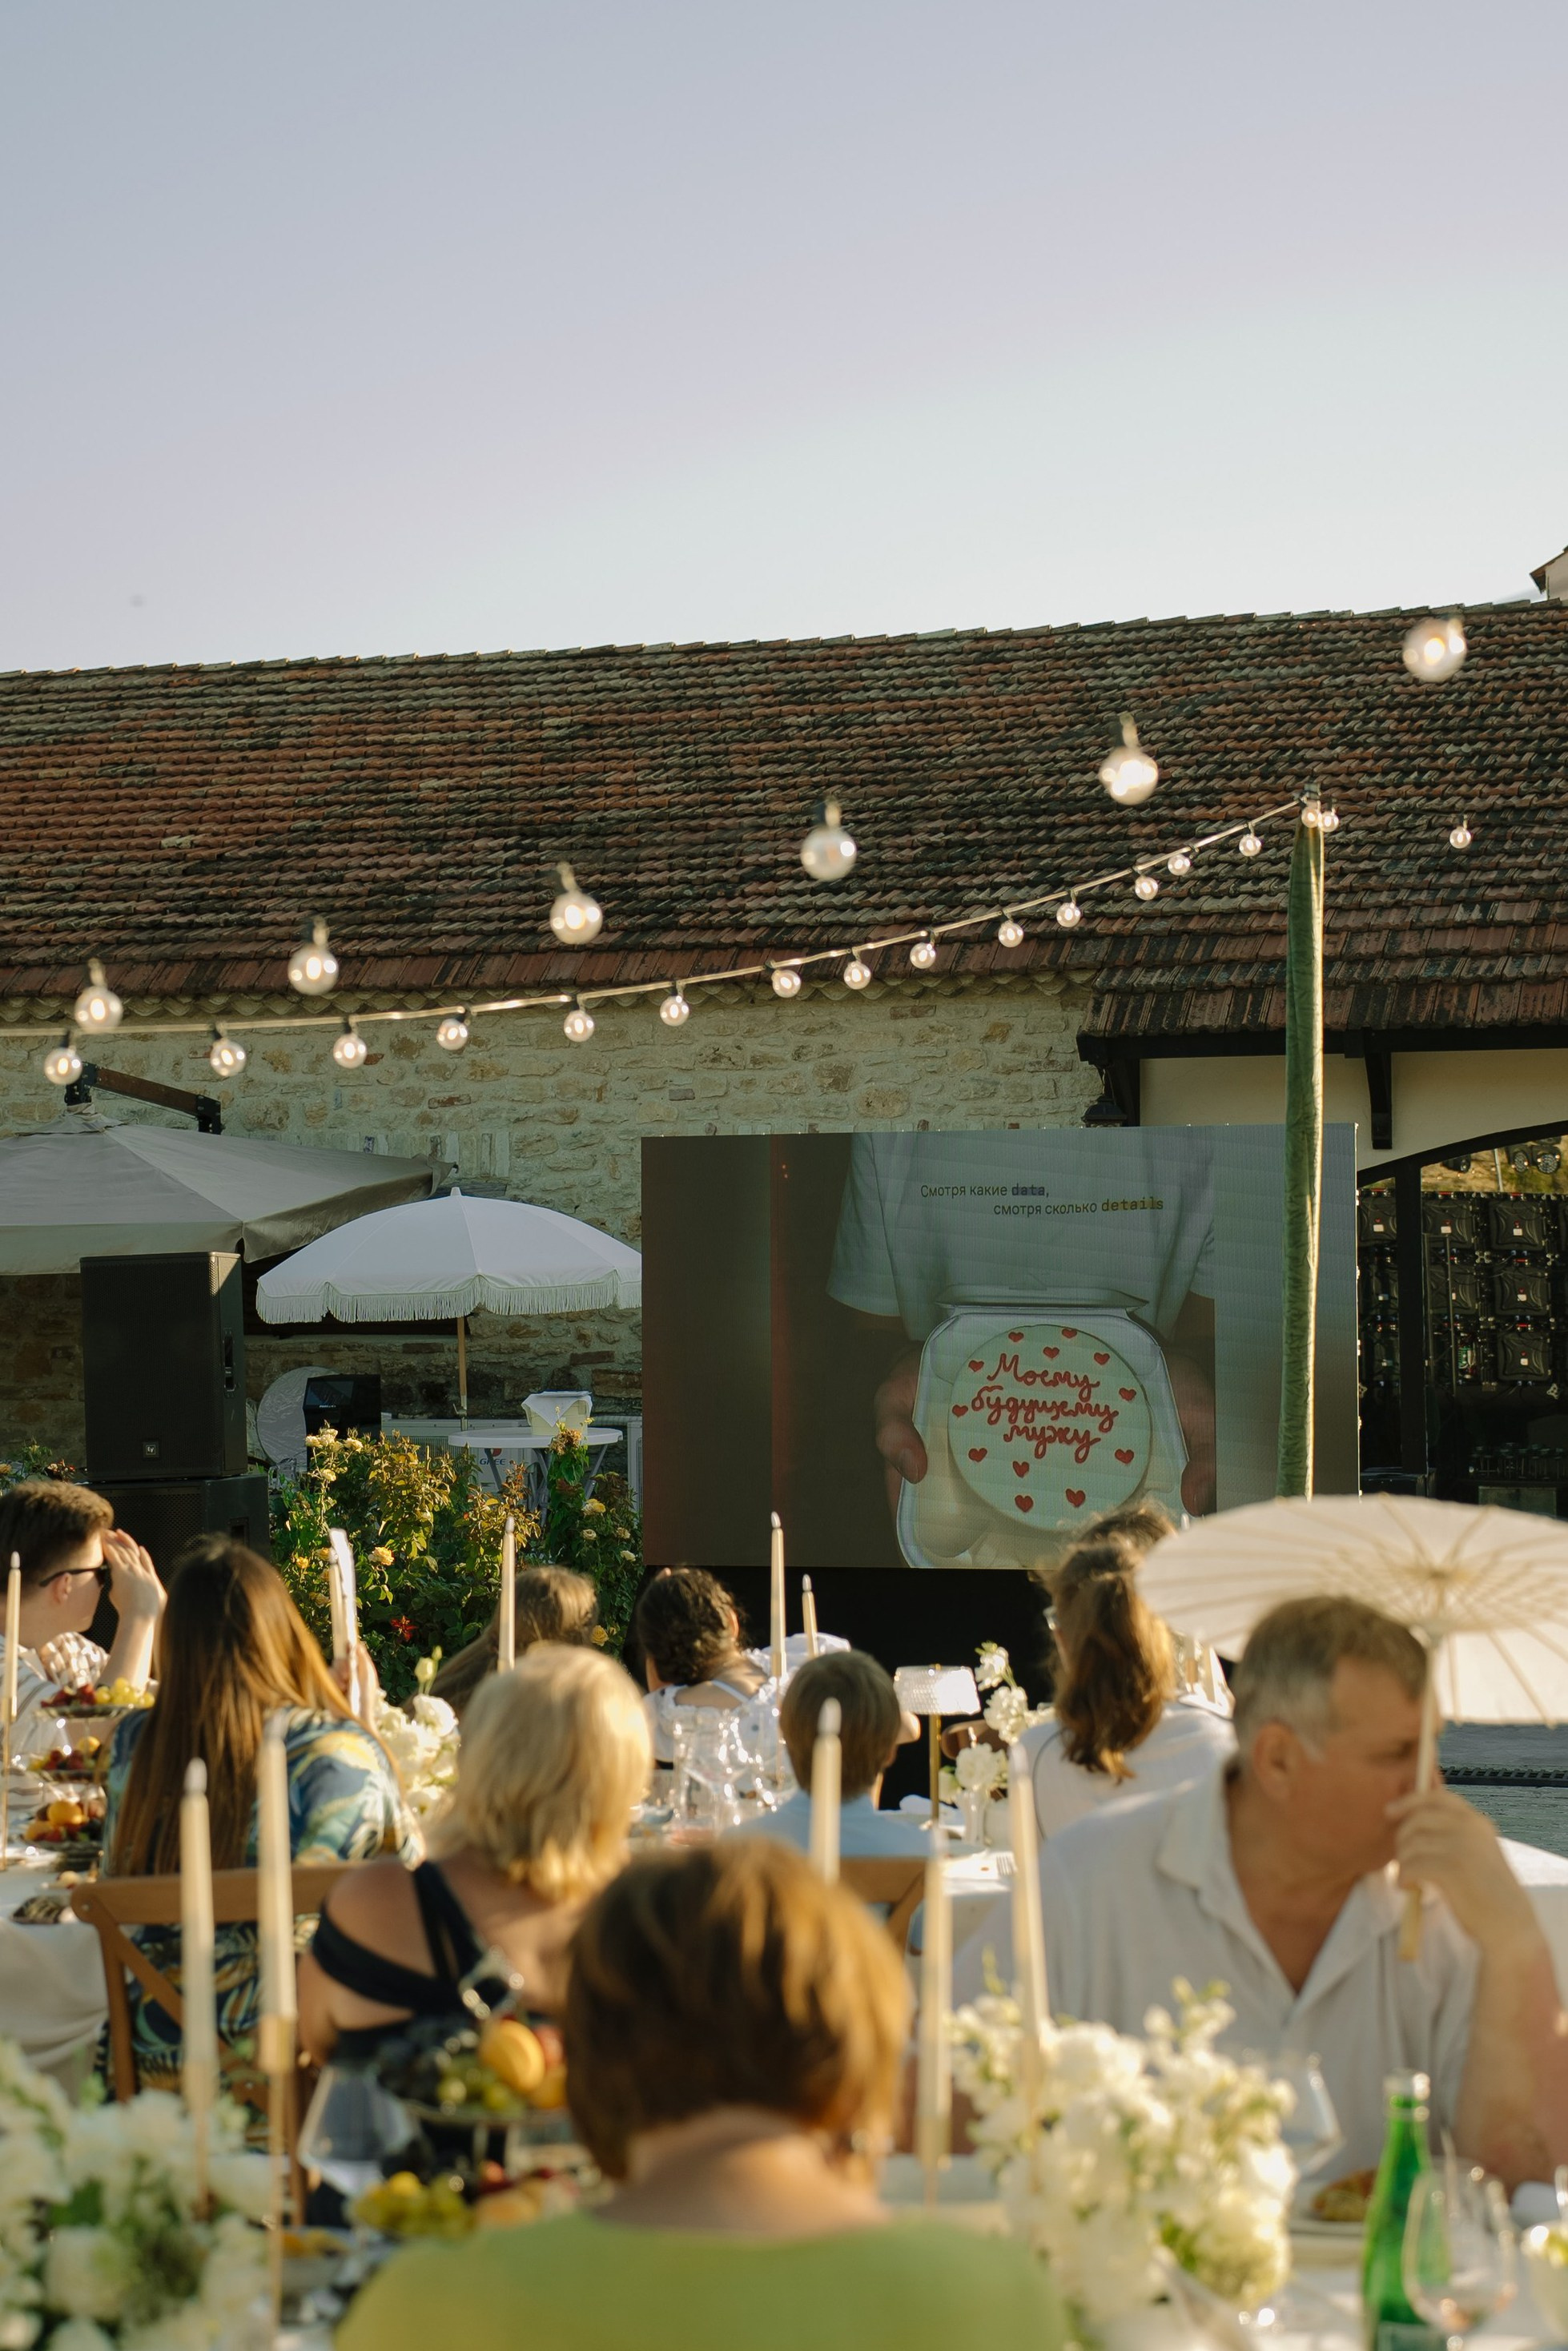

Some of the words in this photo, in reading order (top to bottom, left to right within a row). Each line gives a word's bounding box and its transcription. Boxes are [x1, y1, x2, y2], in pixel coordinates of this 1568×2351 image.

[920, 1184, 966, 1199] Смотря
[970, 1185, 1007, 1196] какие
[1011, 1183, 1049, 1198] data,
[993, 1204, 1042, 1217] смотря
[1045, 1202, 1097, 1215] сколько
[1101, 1196, 1164, 1212] details
[987, 1352, 1100, 1402] Моему
[971, 1385, 1120, 1433] будущему
[1003, 1425, 1101, 1464] мужу
